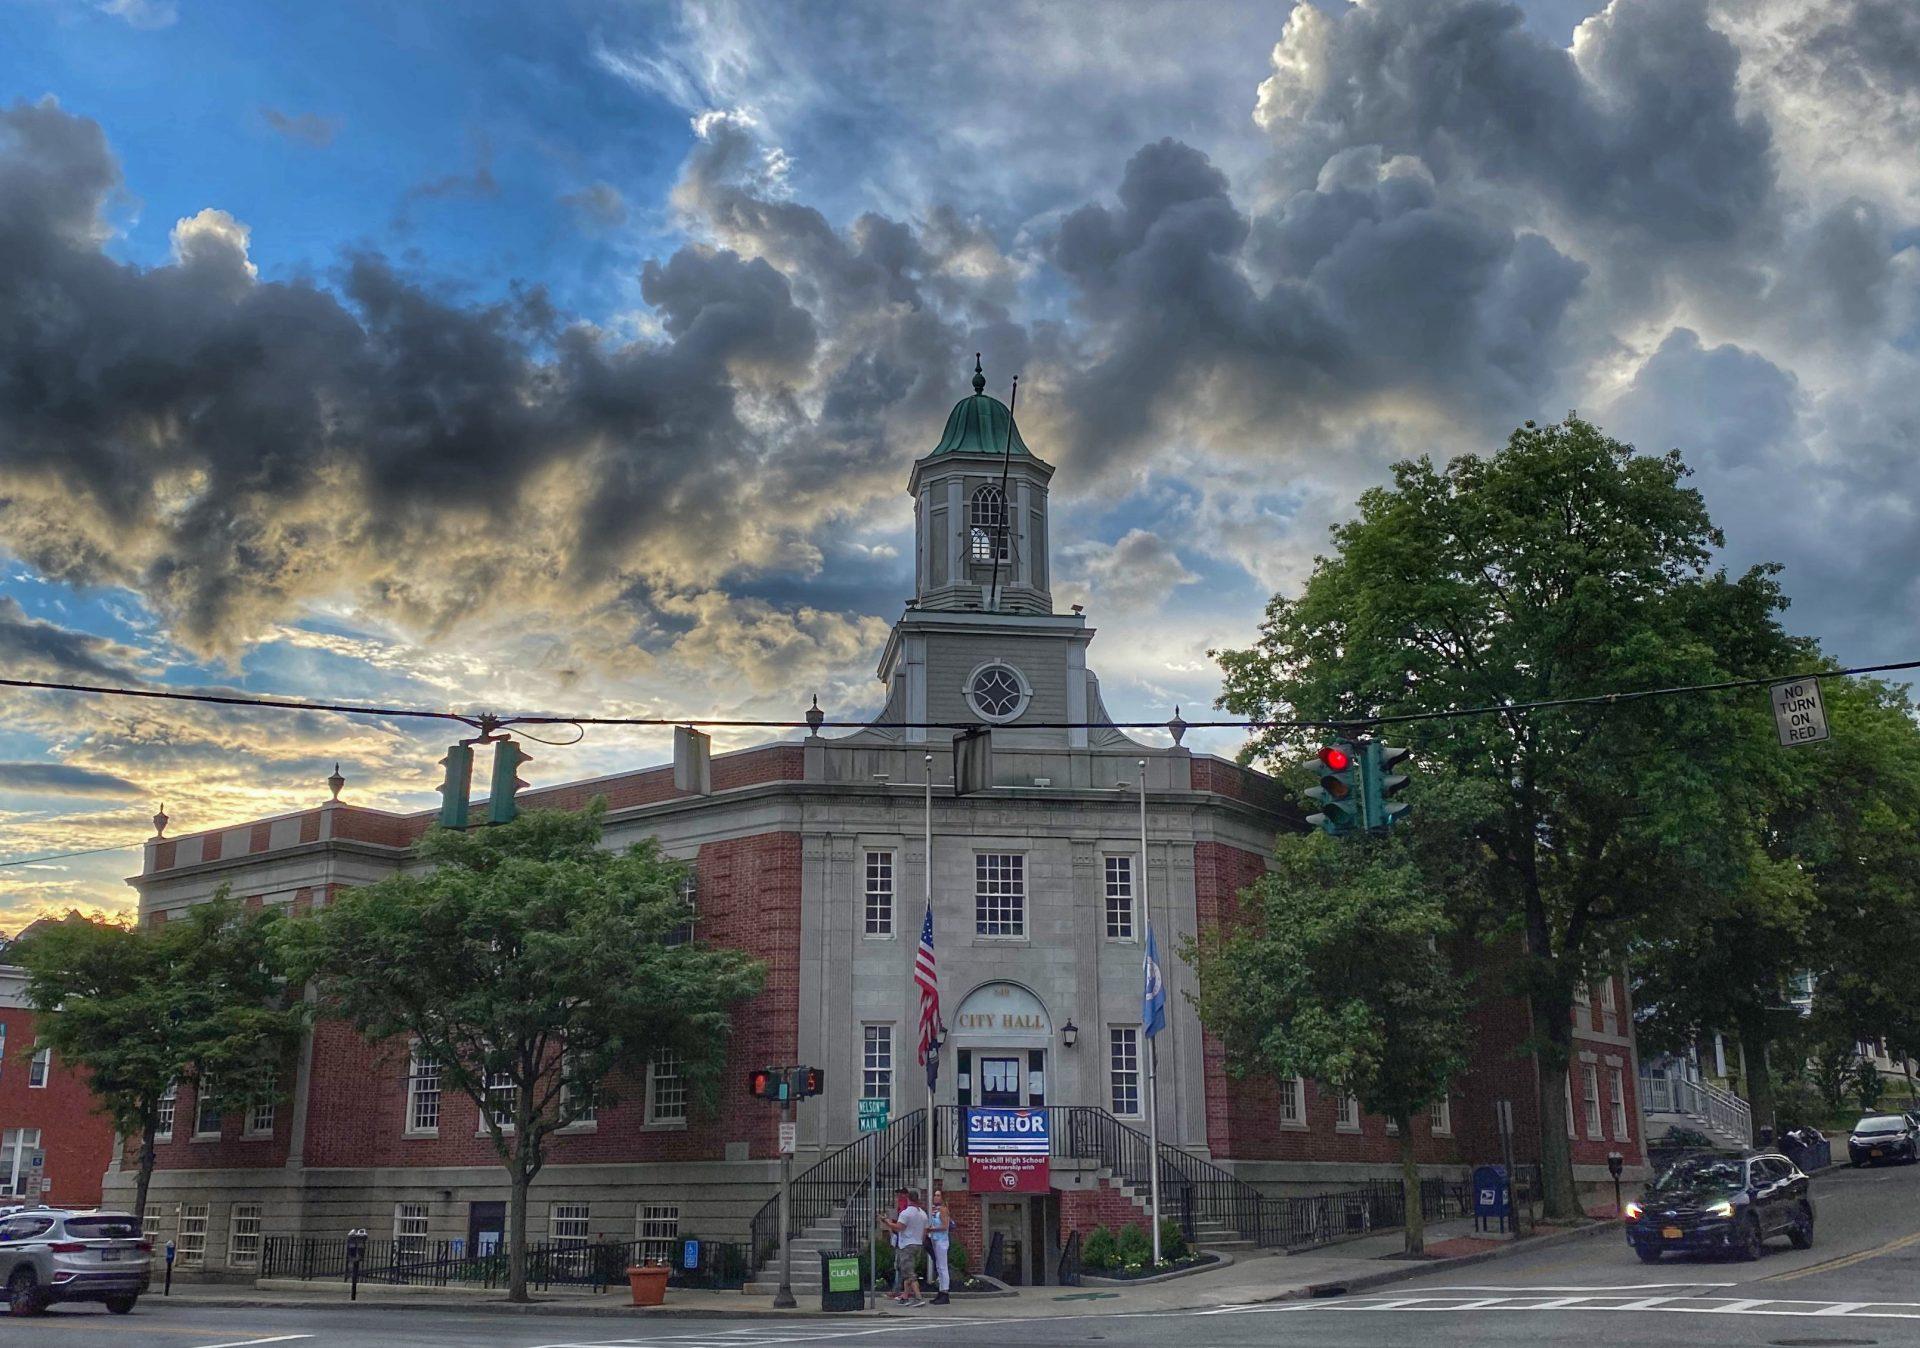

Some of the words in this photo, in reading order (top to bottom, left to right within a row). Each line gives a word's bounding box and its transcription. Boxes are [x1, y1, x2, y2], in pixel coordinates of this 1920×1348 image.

[1784, 686, 1803, 699] NO
[1780, 697, 1816, 714] TURN
[1791, 713, 1810, 726] ON
[1789, 726, 1816, 740] RED
[960, 1014, 995, 1027] CITY
[1003, 1014, 1044, 1028] HALL
[860, 1101, 880, 1113] NELSON
[860, 1118, 877, 1130] MAIN
[971, 1115, 1045, 1132] SENIOR
[1005, 1157, 1020, 1165] High
[831, 1269, 857, 1277] CLEAN
